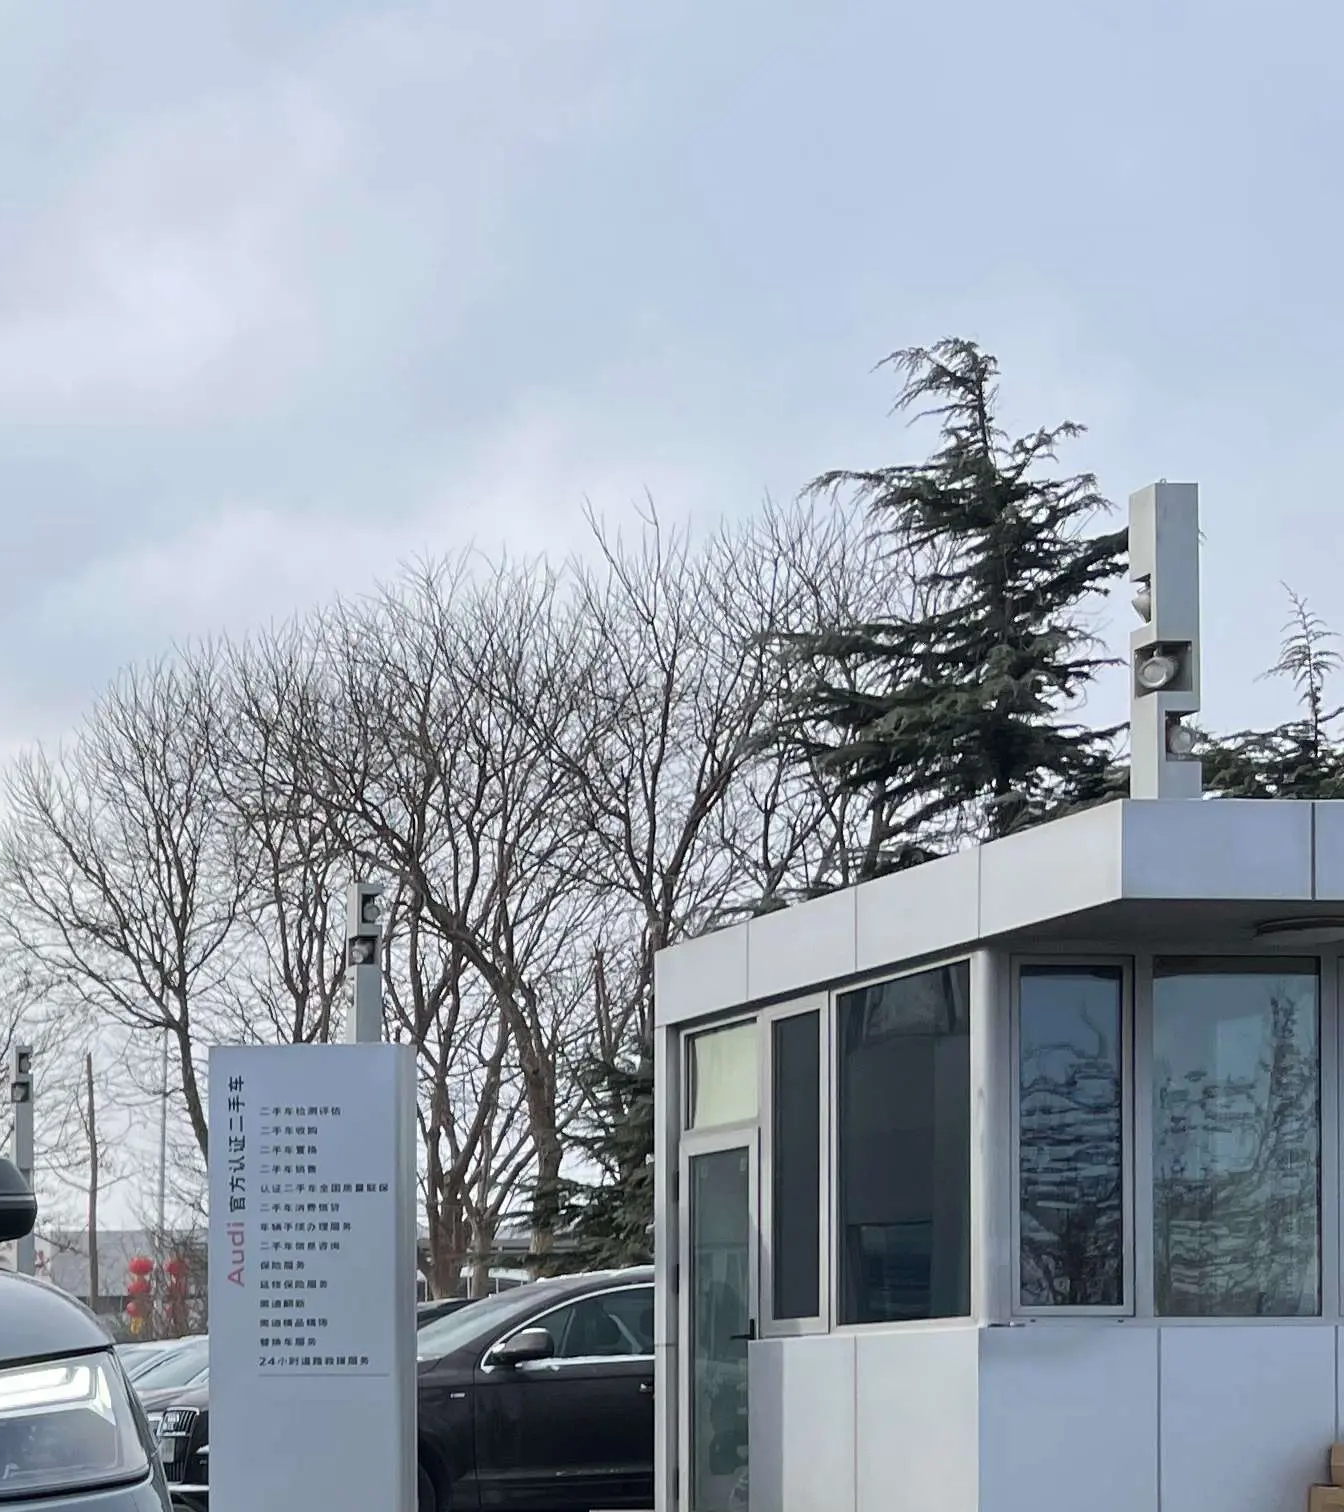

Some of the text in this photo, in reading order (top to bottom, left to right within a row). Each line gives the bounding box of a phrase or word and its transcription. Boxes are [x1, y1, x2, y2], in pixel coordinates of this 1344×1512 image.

[227, 1075, 246, 1288] Audi 官方认证二手车
